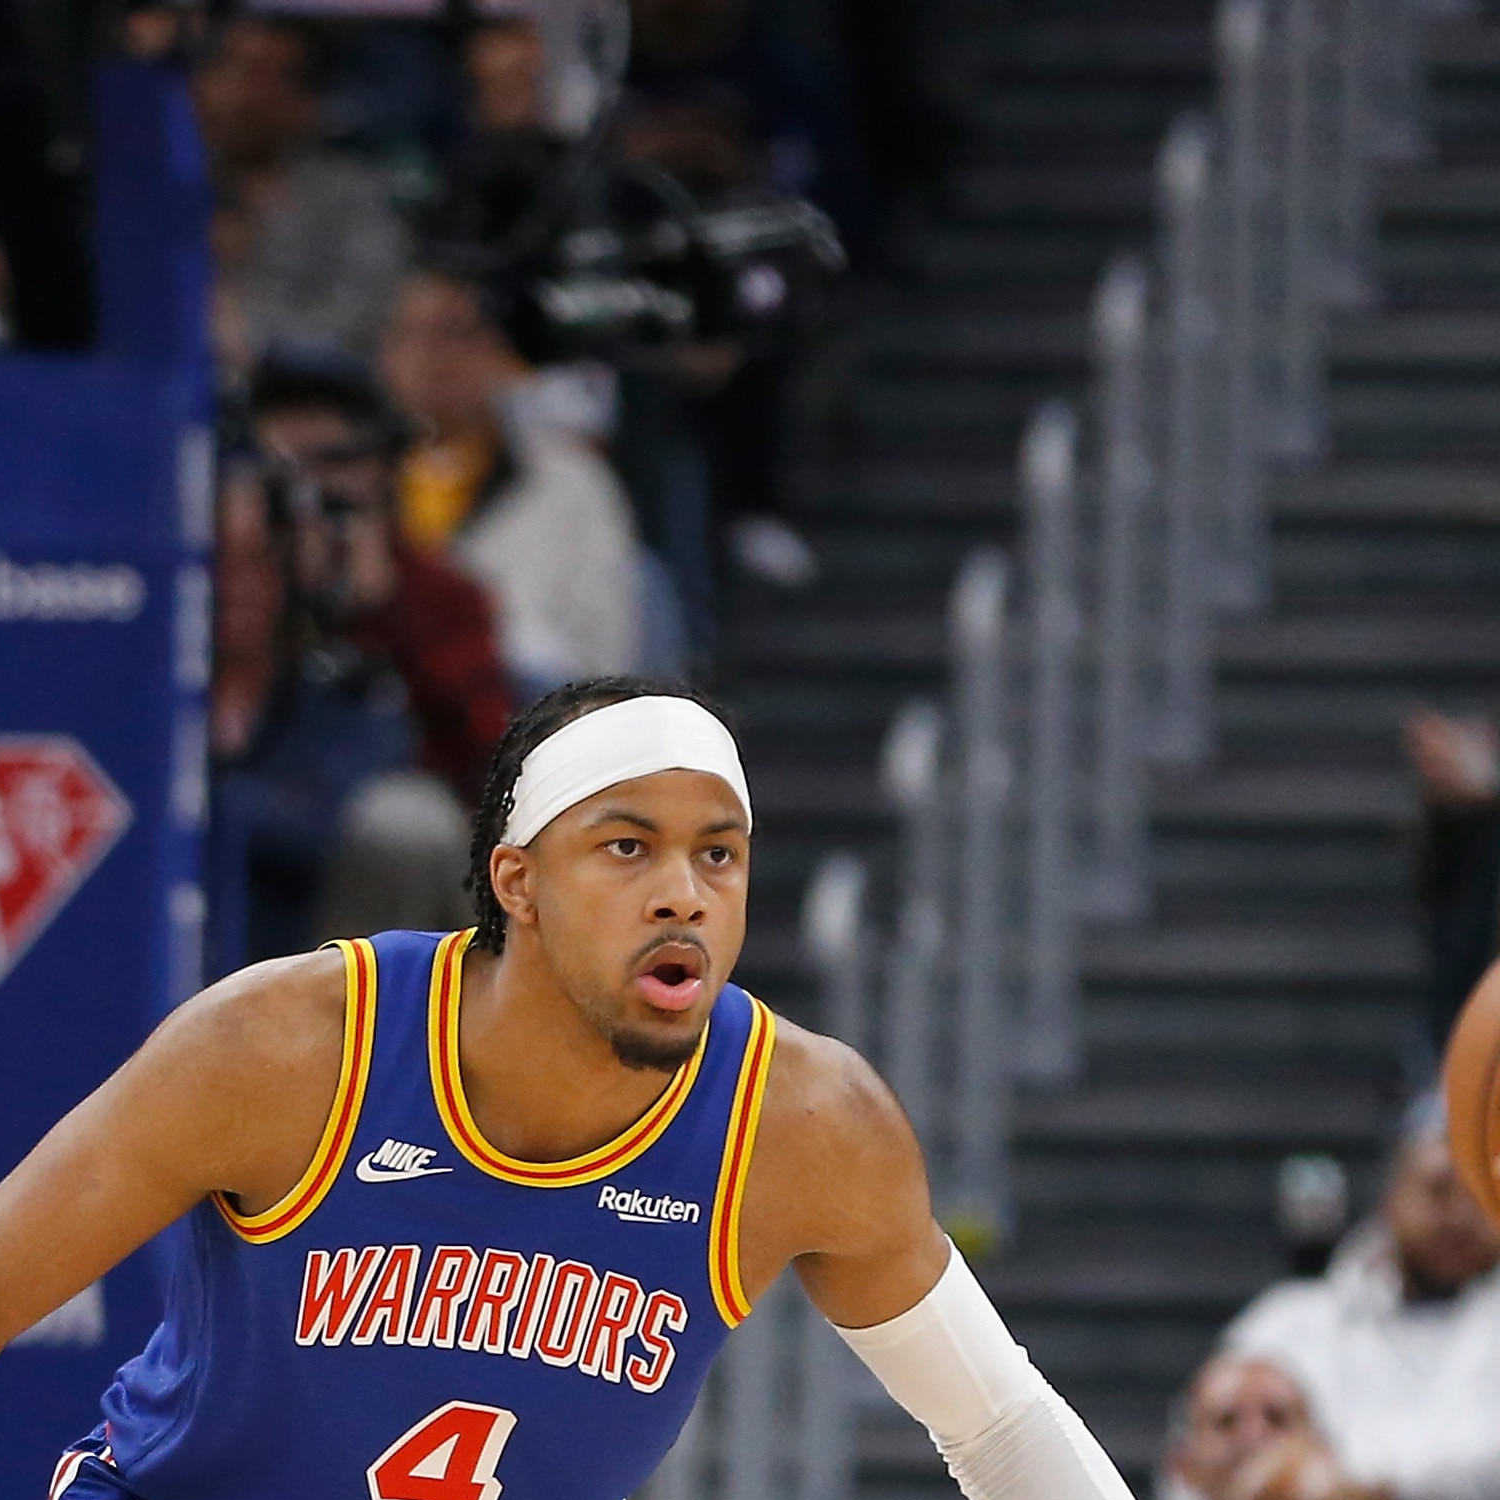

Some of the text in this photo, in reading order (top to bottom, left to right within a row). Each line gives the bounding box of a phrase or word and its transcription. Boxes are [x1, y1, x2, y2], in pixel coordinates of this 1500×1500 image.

[371, 1138, 438, 1172] NIKE
[597, 1185, 700, 1223] Rakuten
[295, 1245, 688, 1393] WARRIORS
